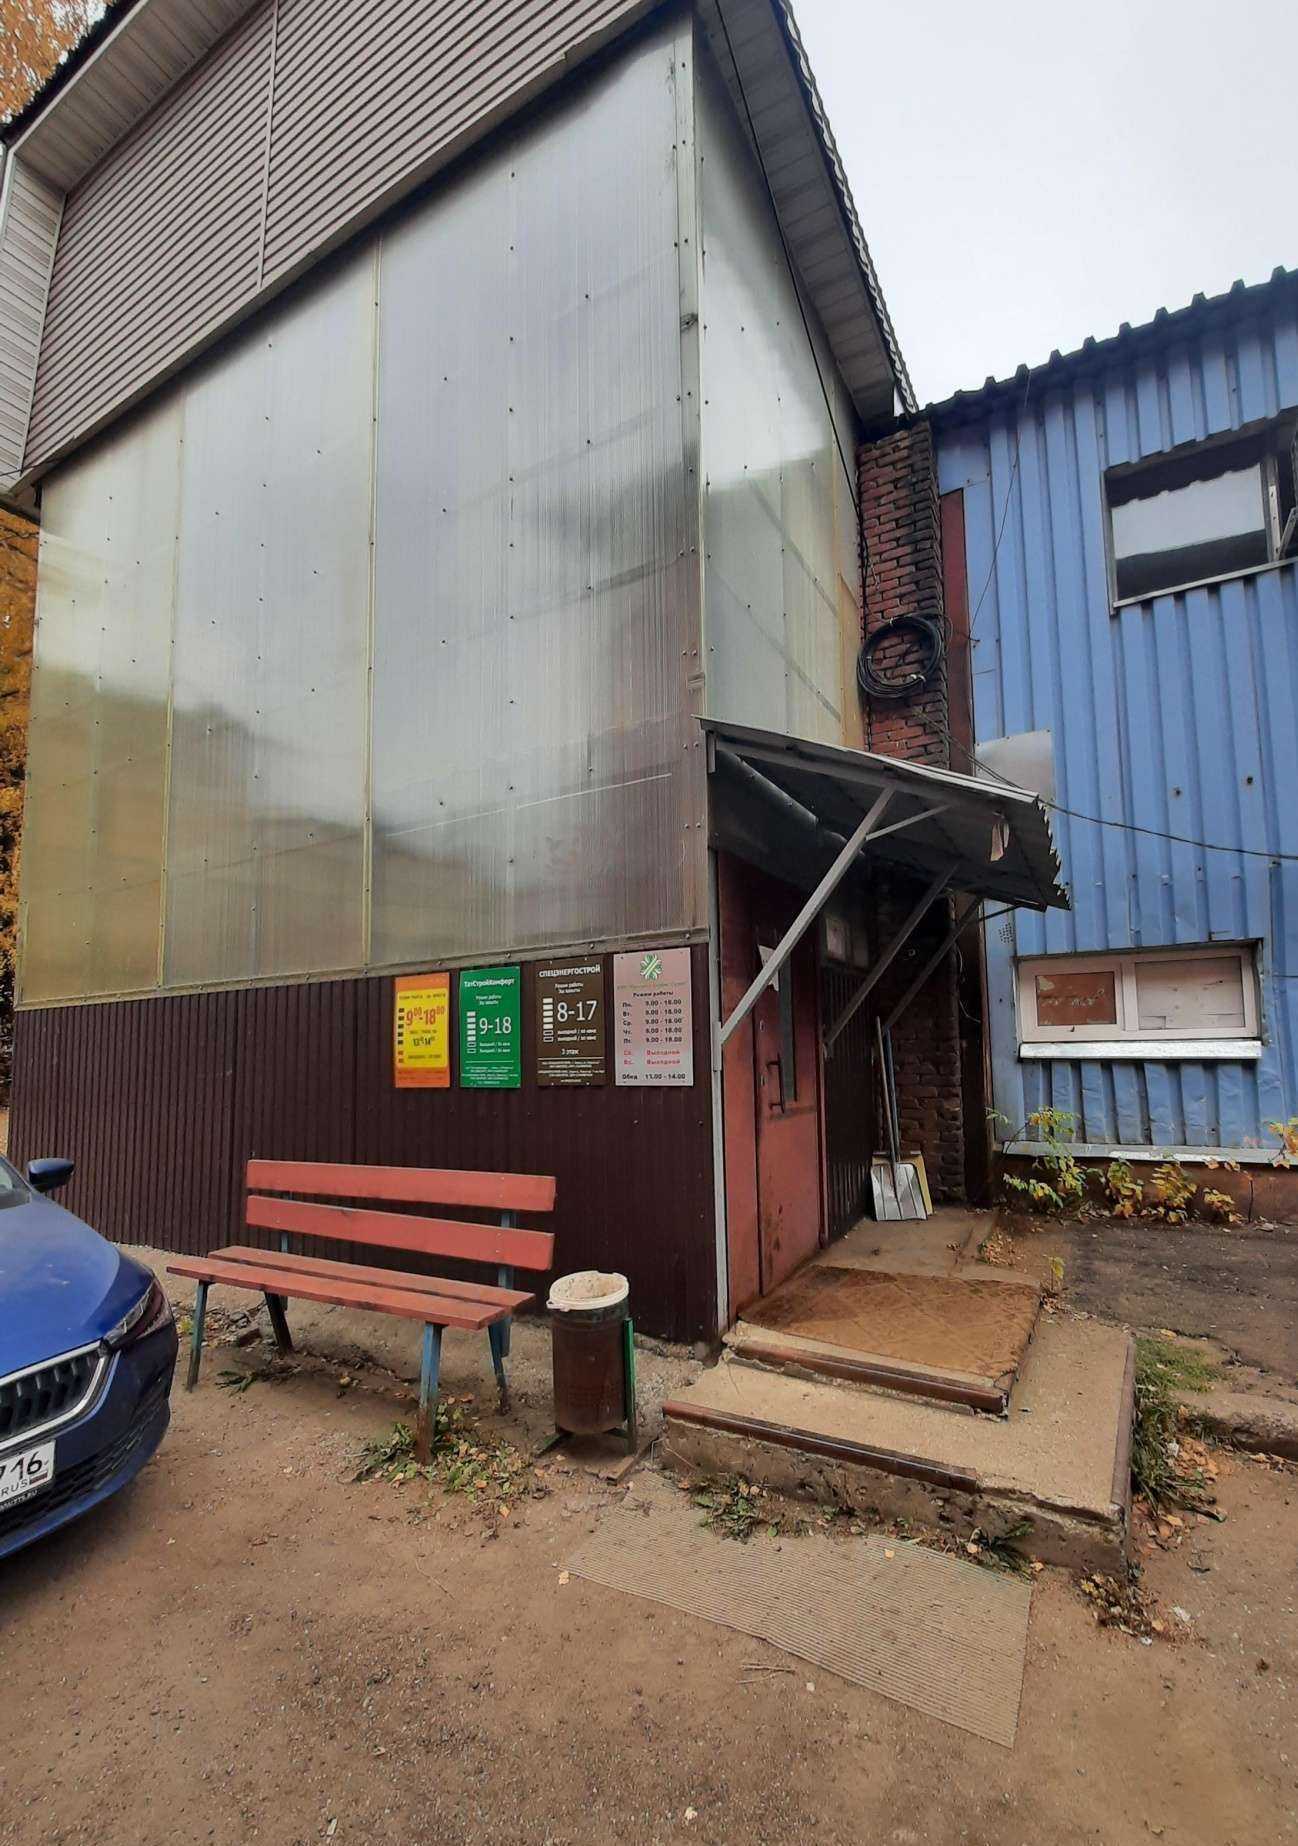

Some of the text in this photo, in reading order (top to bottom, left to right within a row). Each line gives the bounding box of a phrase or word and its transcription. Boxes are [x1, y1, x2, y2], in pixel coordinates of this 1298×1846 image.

[539, 963, 601, 977] СПЕЦЭНЕРГОСТРОЙ
[557, 1000, 598, 1022] 8-17
[479, 1016, 512, 1035] 9-18
[1, 1479, 28, 1497] RUS
